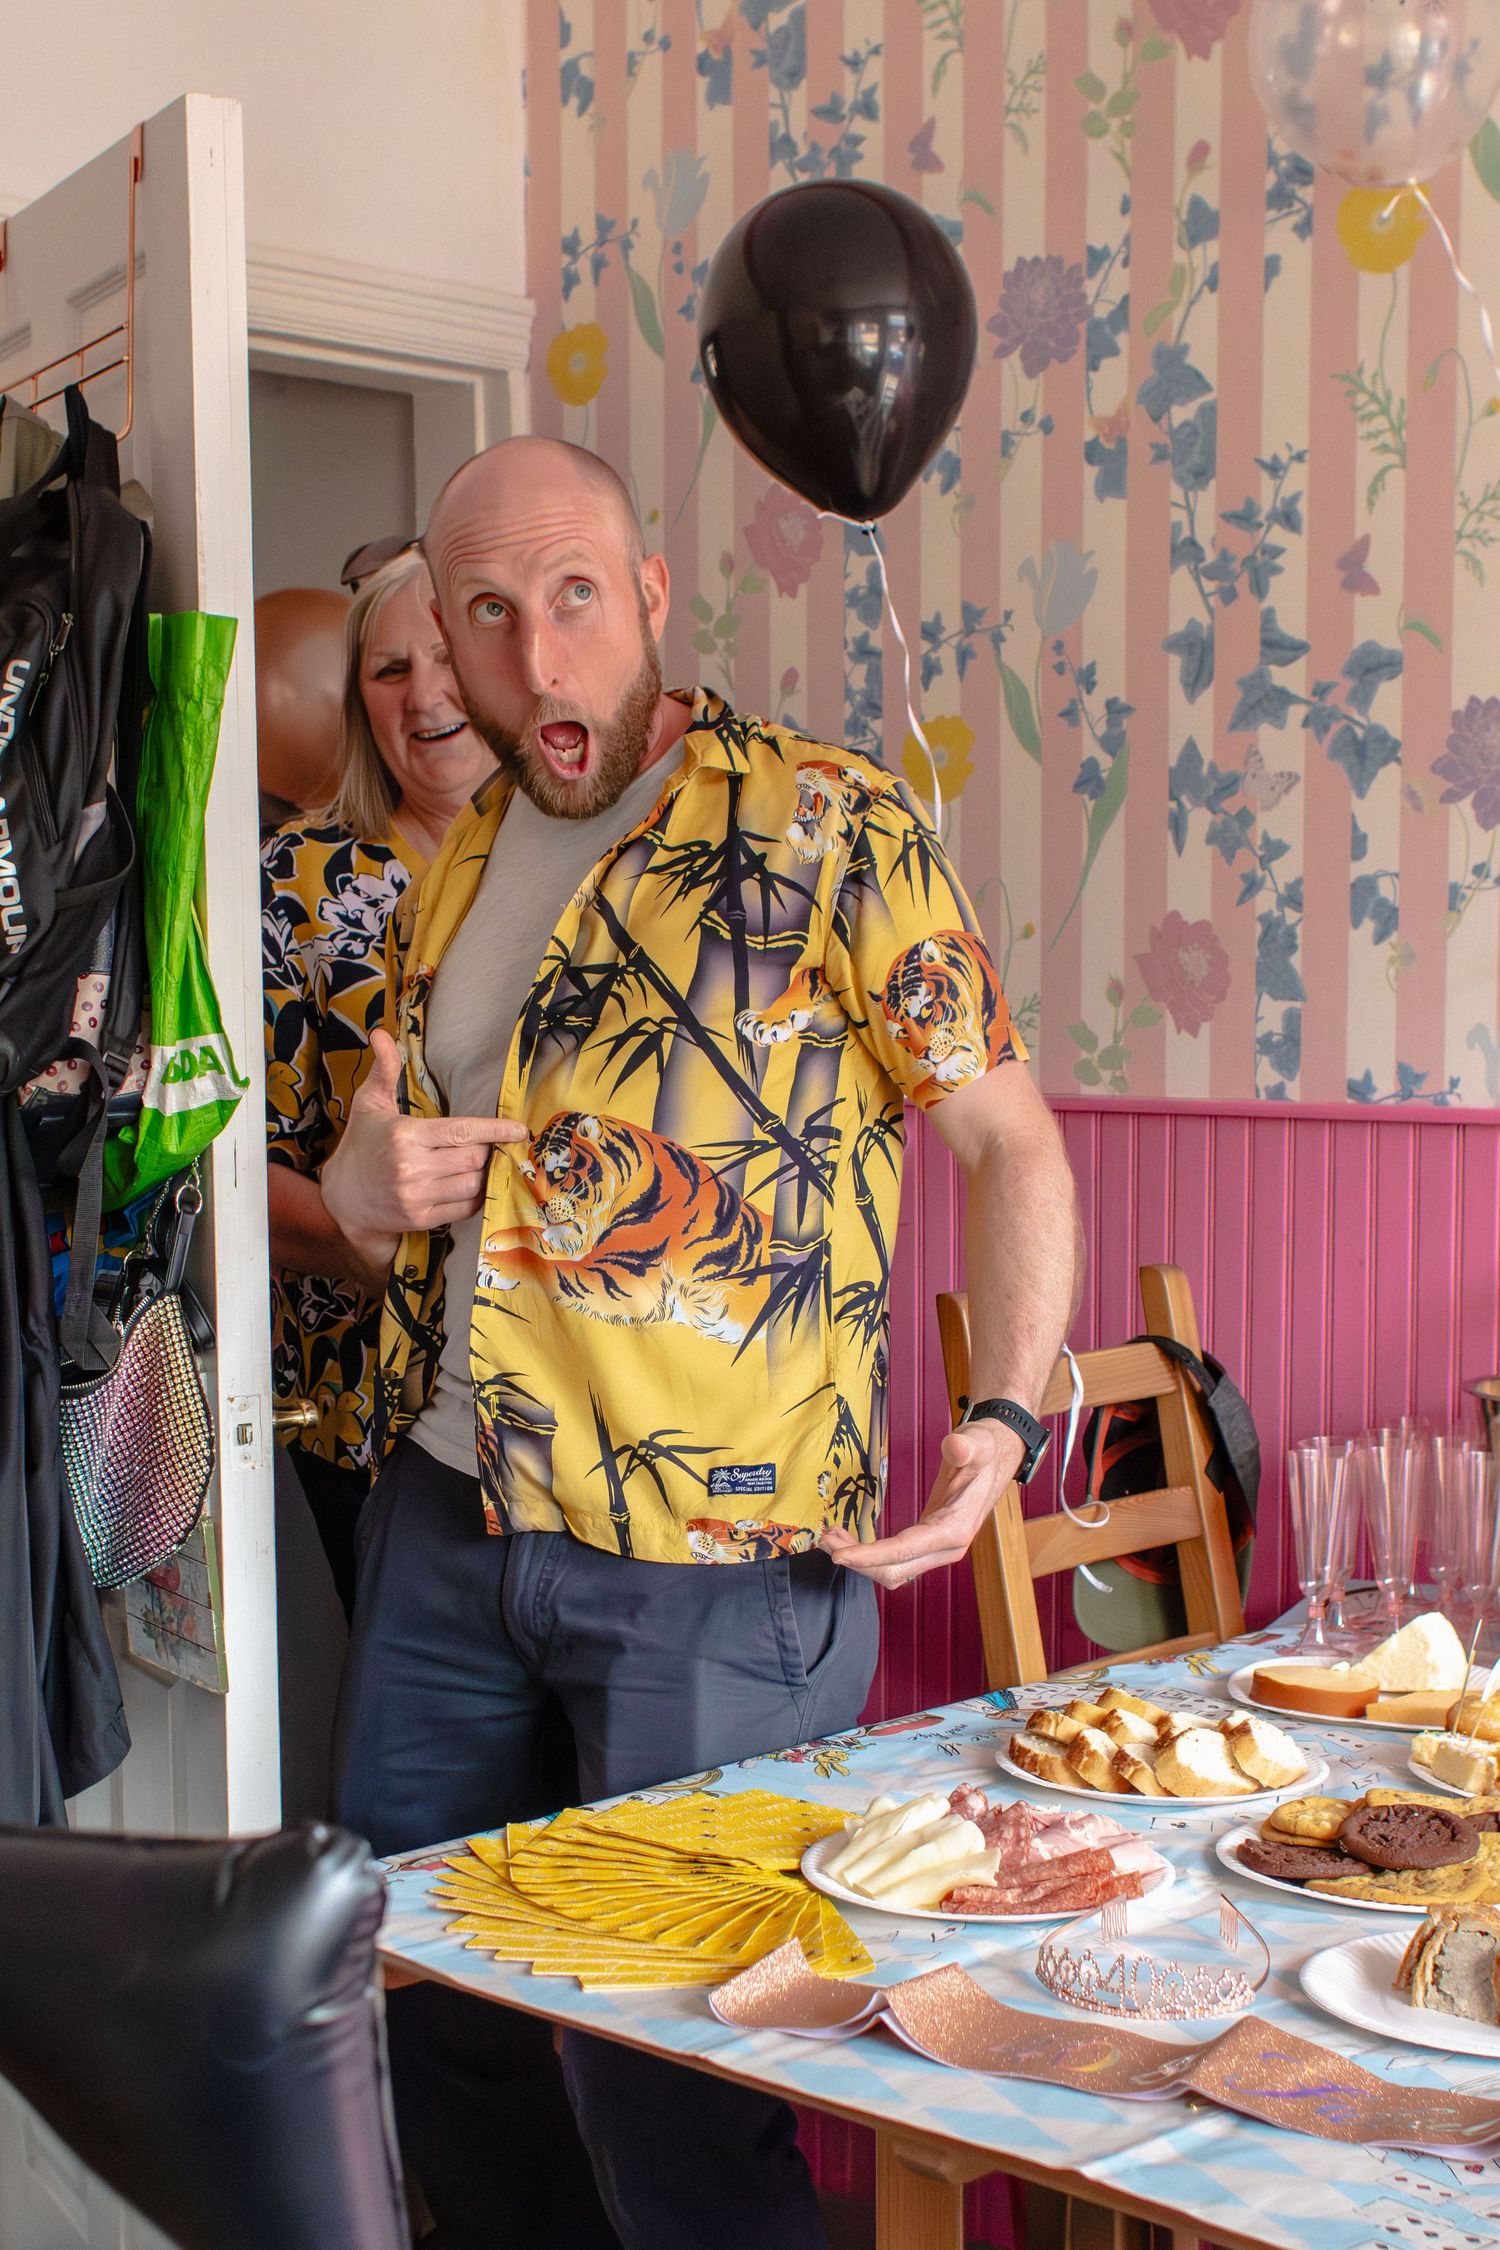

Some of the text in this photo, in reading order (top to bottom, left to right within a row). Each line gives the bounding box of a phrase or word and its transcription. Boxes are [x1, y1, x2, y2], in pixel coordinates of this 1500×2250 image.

[0, 659, 31, 954] UND MOUR
[730, 1467, 772, 1483] Superdry
[1097, 1953, 1157, 2017] 40
